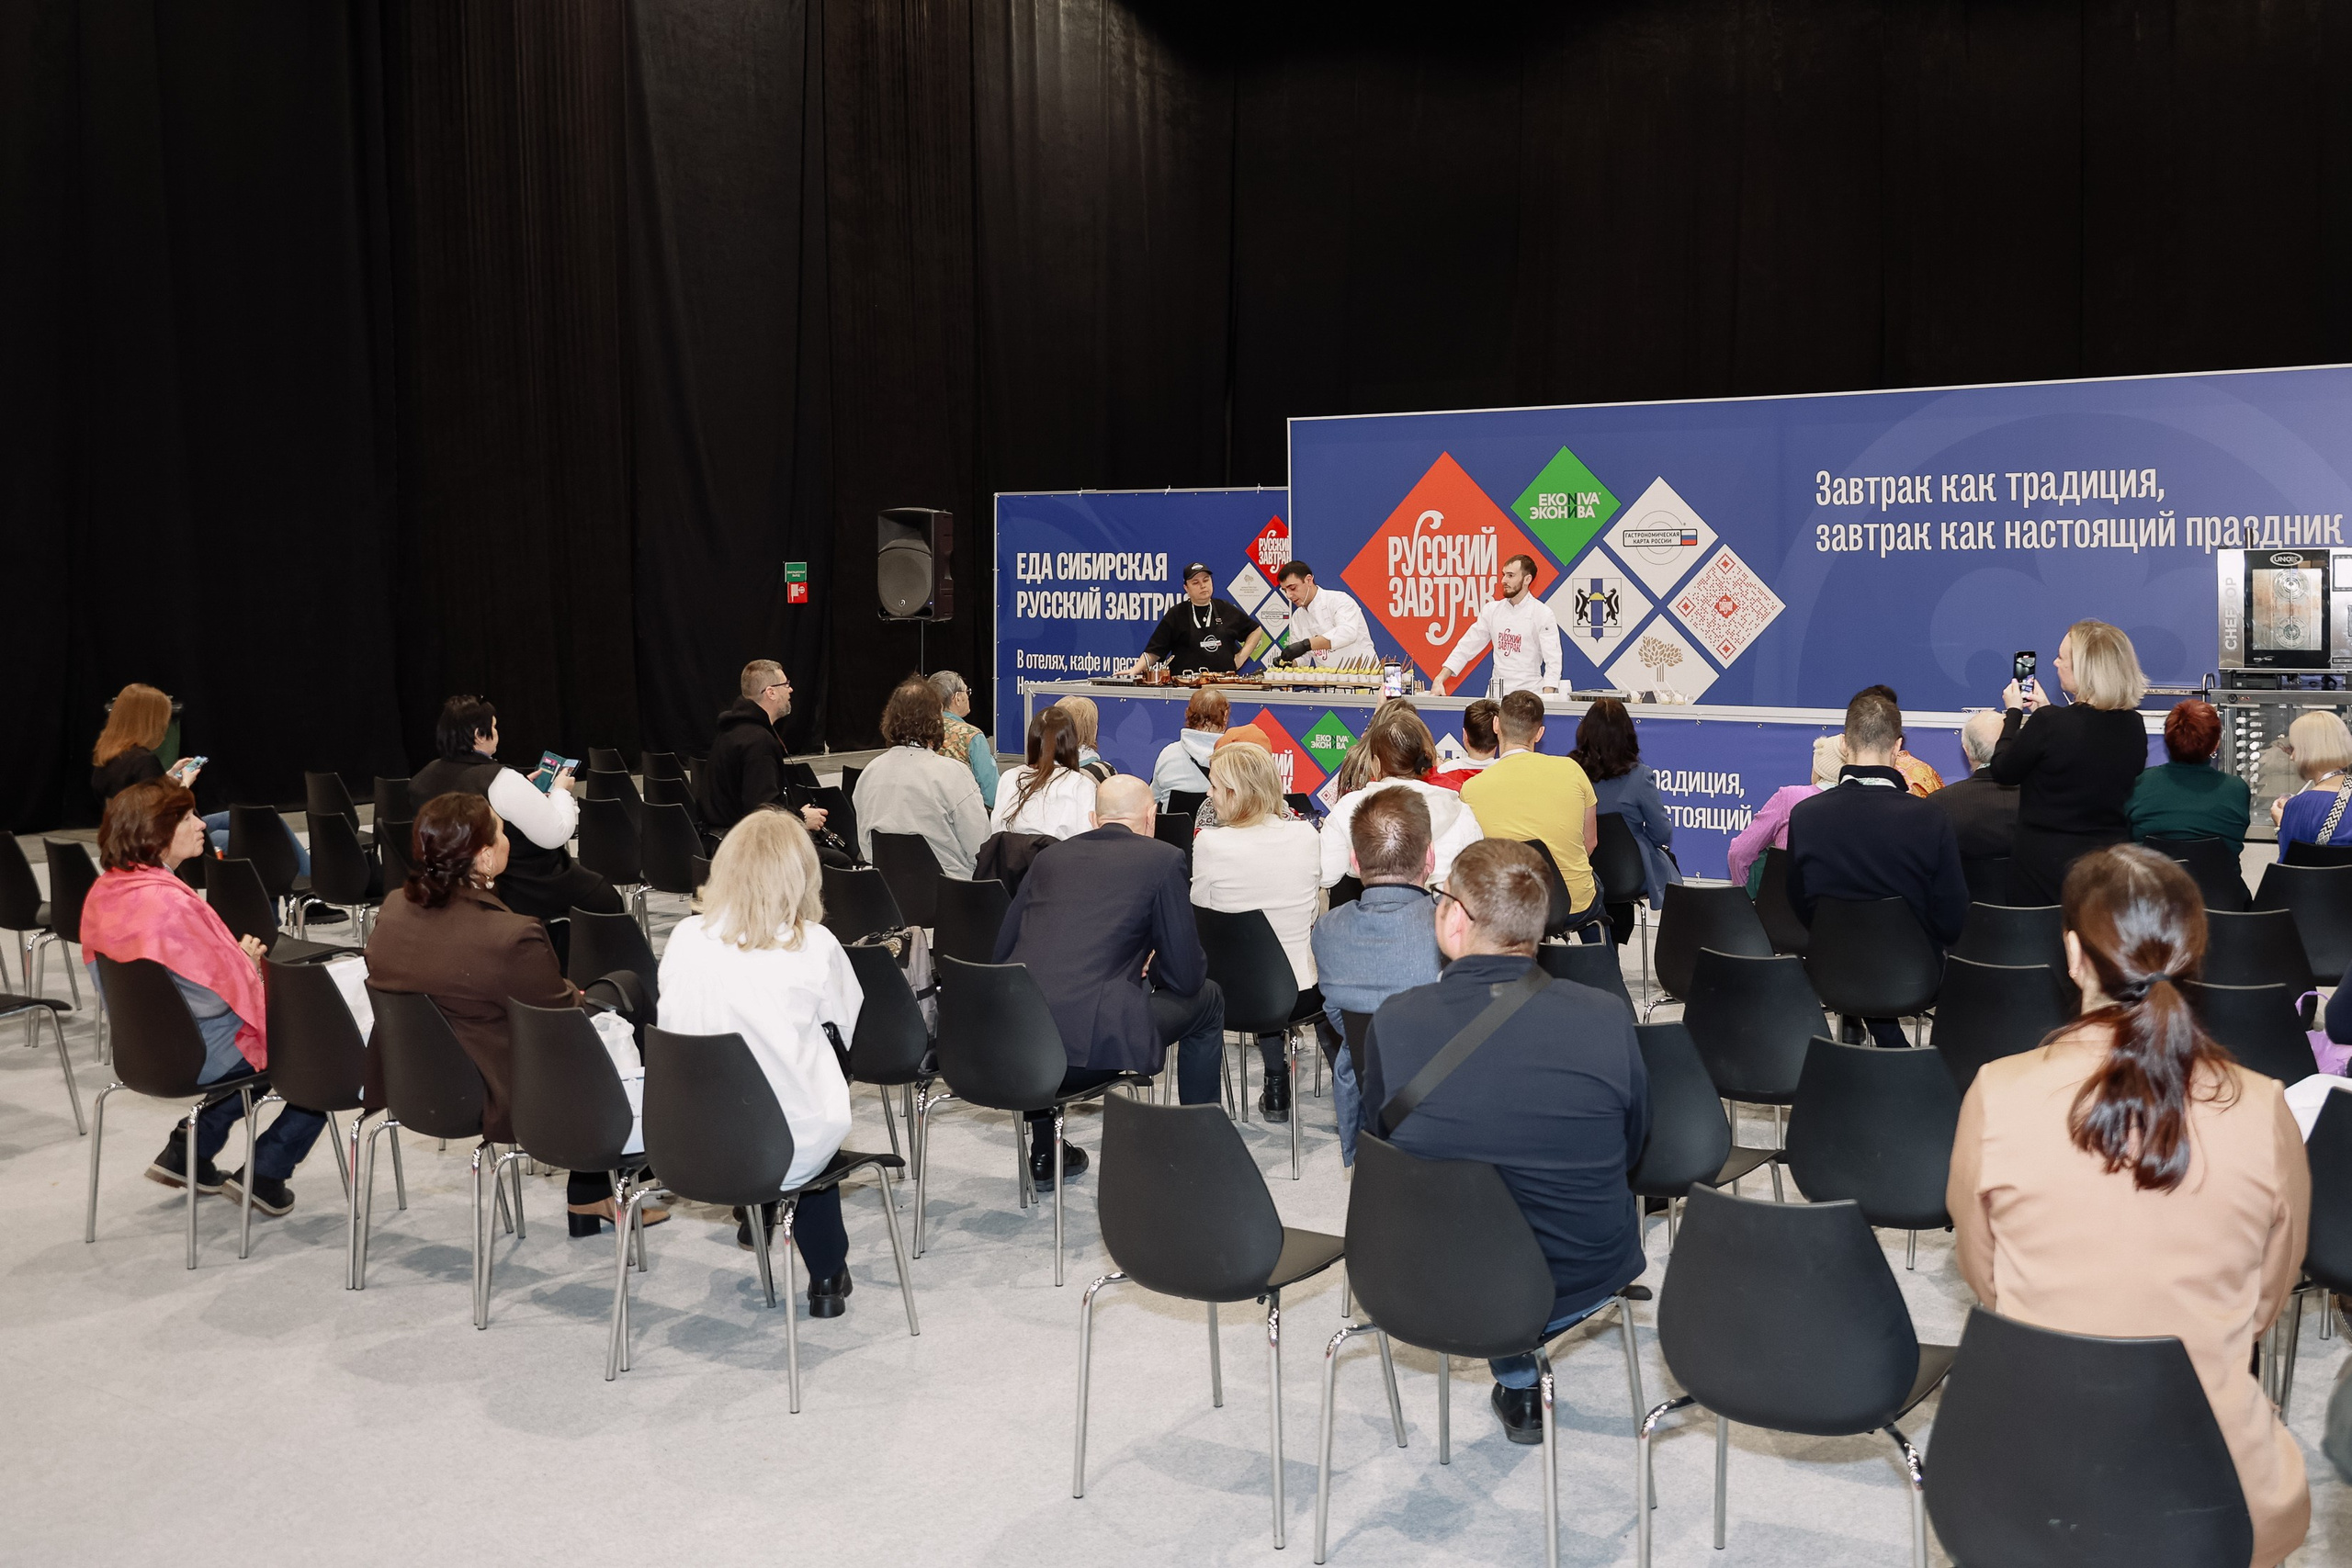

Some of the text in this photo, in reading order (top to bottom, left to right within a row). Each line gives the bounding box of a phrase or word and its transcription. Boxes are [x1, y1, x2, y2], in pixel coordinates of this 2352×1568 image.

[1538, 491, 1600, 506] EKONIVA
[1815, 468, 2165, 512] Завтрак как традиция,
[1529, 505, 1596, 520] ЭКОНИВА
[1258, 529, 1289, 552] РУССКИ
[1387, 509, 1498, 577] РУССКИЙ
[1815, 510, 2345, 558] завтрак как настоящий праздник
[1016, 552, 1168, 585] ЕДА СИБИРСКАЯ
[1016, 586, 1190, 621] РУССКИЙ ЗАВТРА
[1016, 649, 1024, 669] В
[1026, 653, 1068, 672] отелях,
[1070, 651, 1101, 675] кафе
[1103, 656, 1111, 671] и
